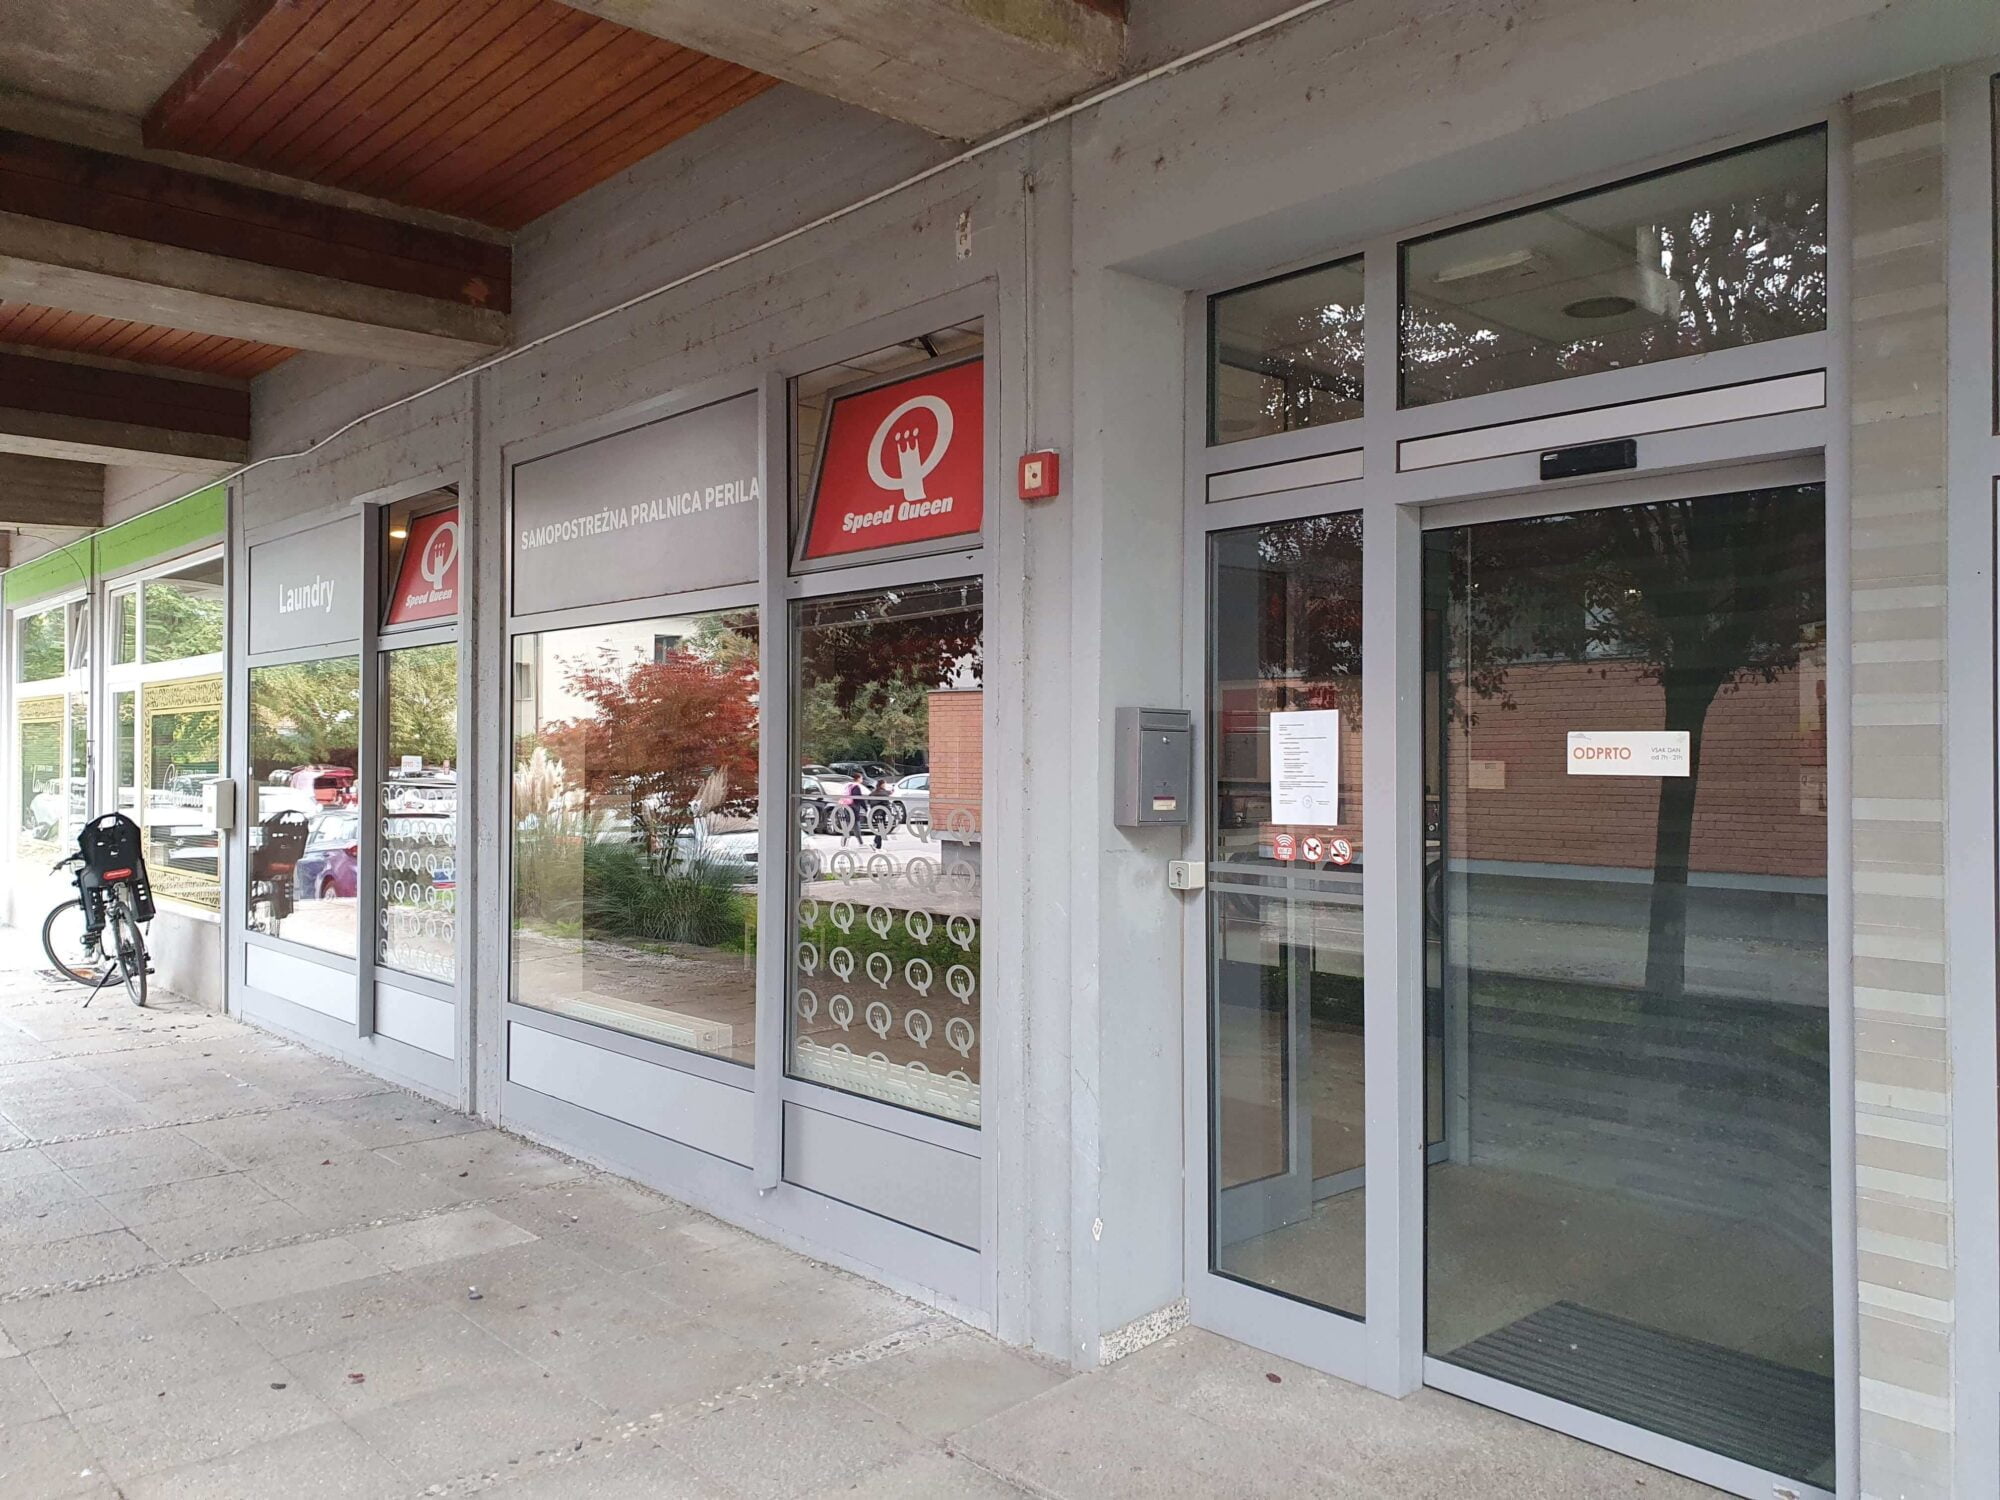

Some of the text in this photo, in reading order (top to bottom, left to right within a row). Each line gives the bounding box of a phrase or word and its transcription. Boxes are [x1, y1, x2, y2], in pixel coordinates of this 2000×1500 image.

[521, 477, 760, 550] SAMOPOSTREŽNA PRALNICA PERILA
[842, 496, 953, 534] Speed Queen
[279, 575, 335, 614] Laundry
[405, 589, 453, 608] Speed Queen
[1573, 747, 1632, 760] ODPRTO
